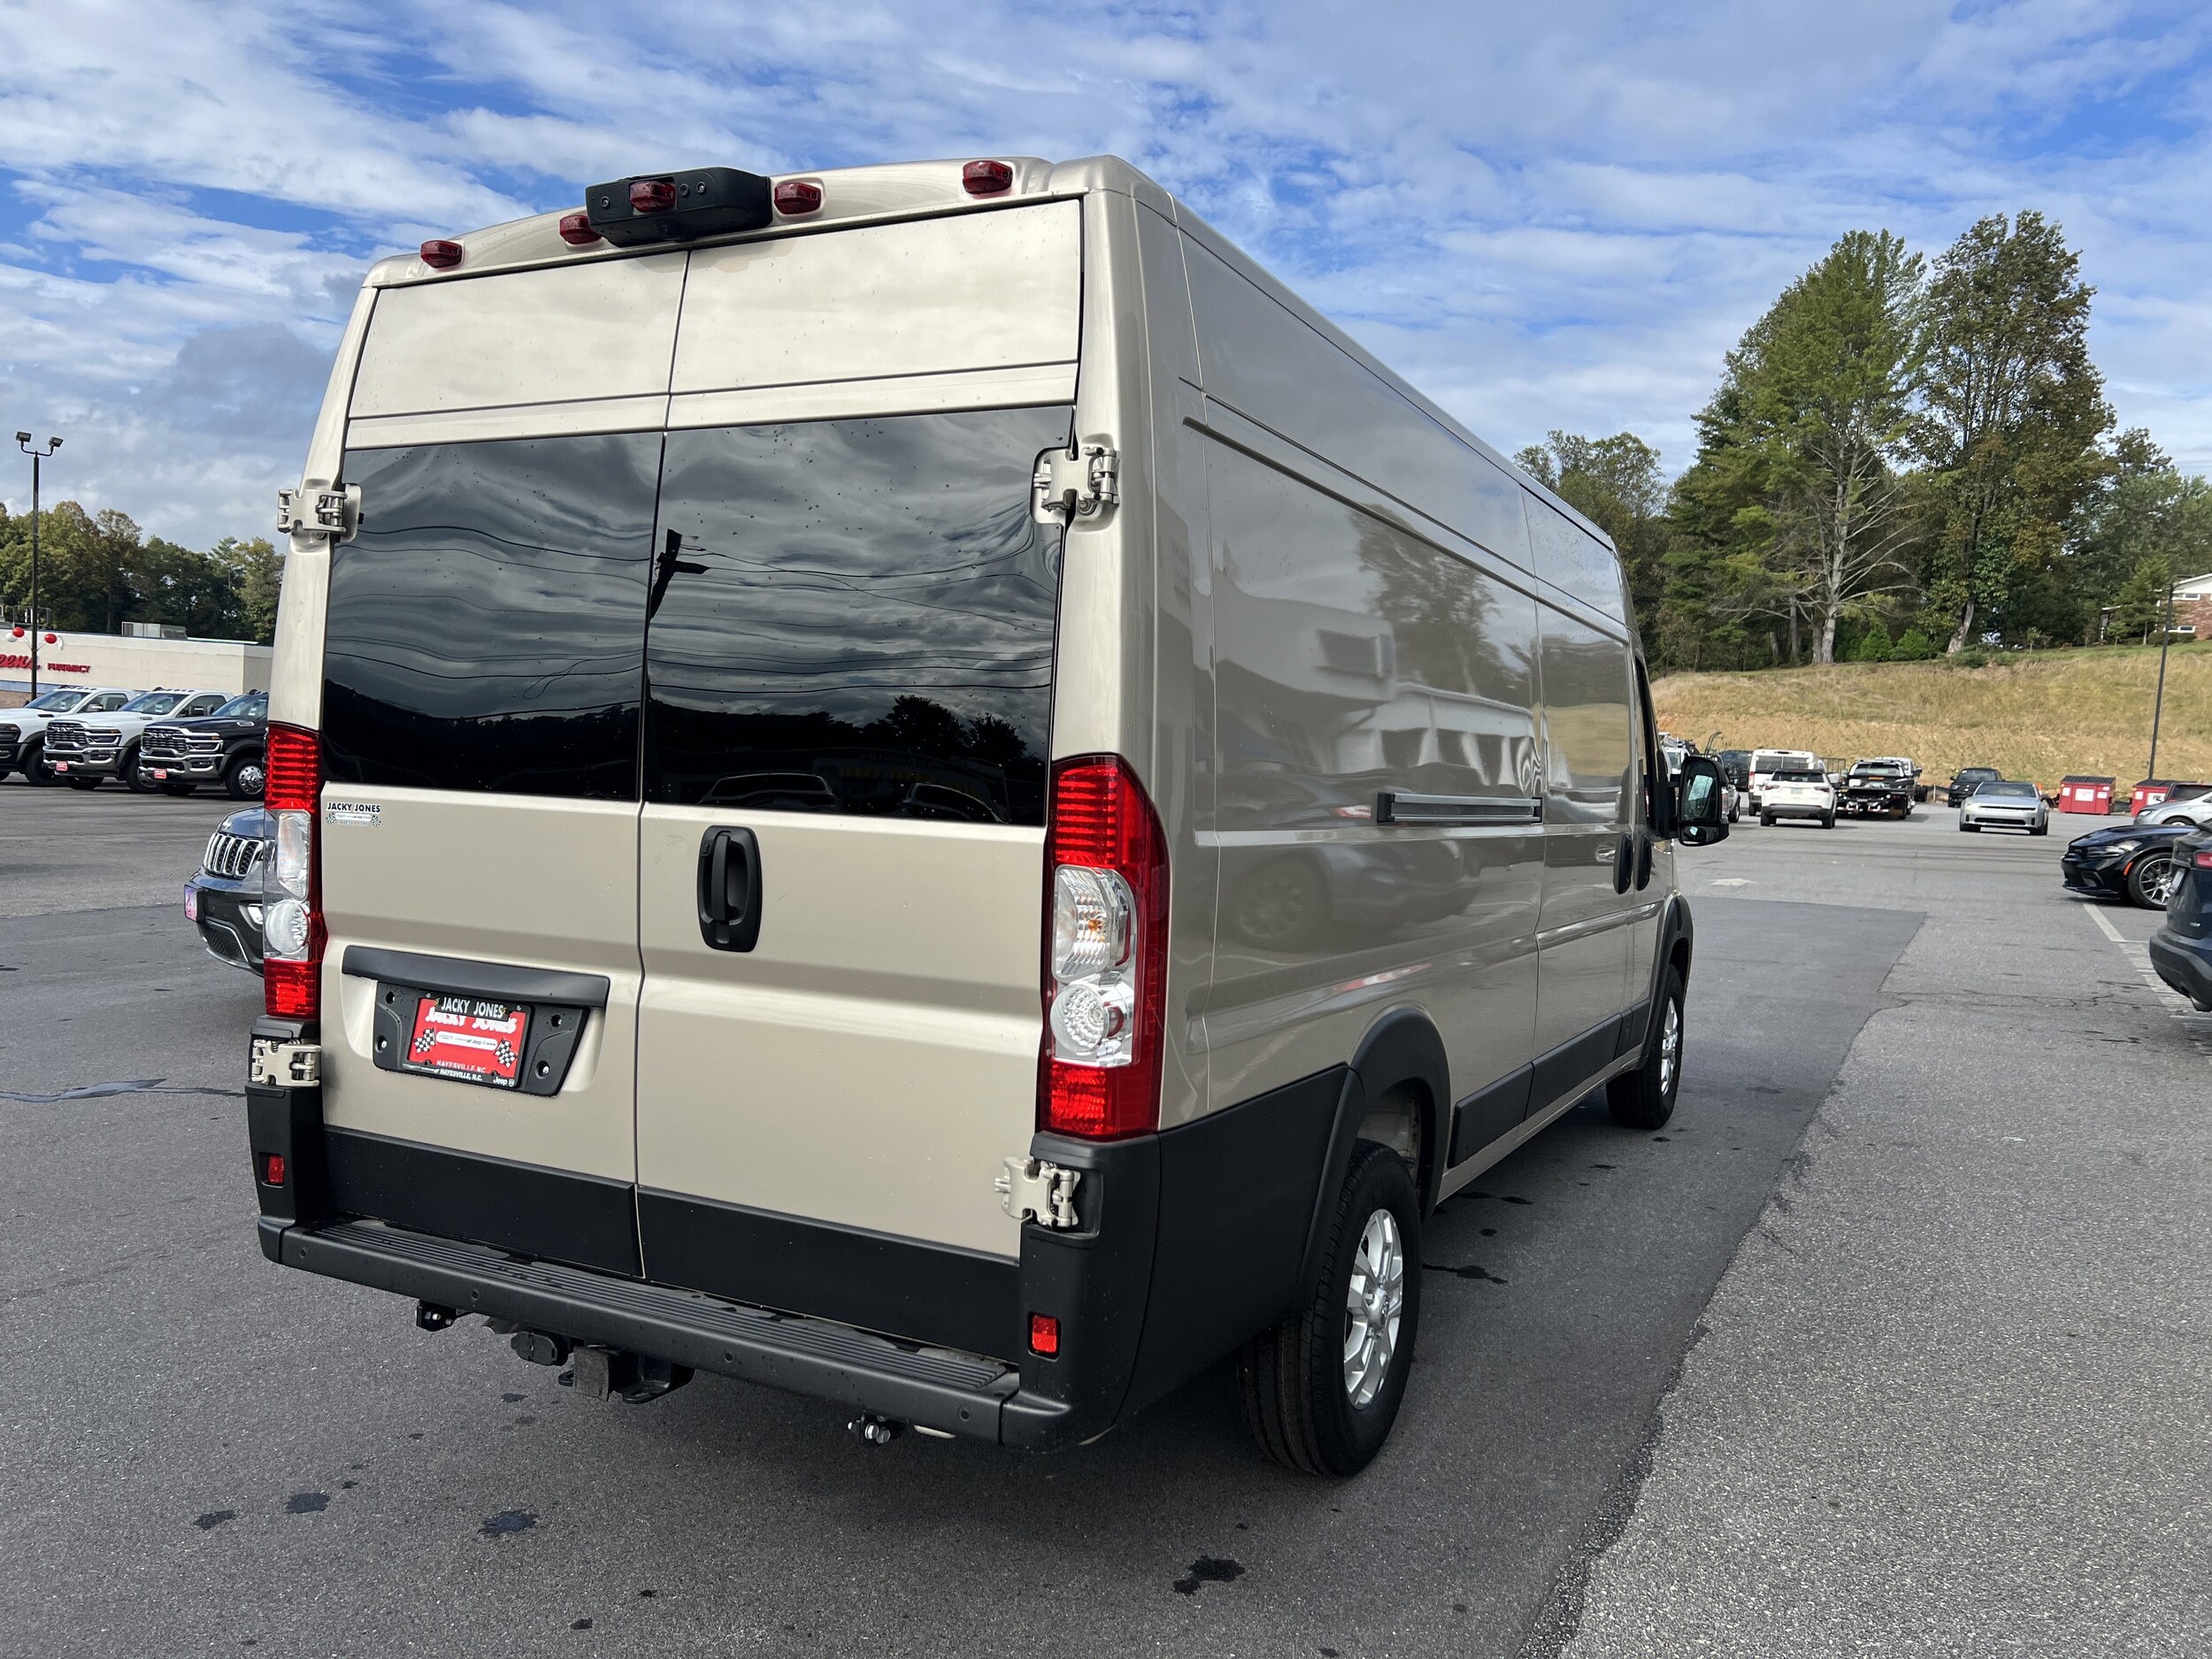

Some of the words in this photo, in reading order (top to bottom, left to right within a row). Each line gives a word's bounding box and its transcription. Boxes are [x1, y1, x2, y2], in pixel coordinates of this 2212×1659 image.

[47, 663, 91, 673] PHARMACY
[326, 802, 352, 811] JACKY
[354, 803, 380, 813] JONES
[441, 996, 471, 1014] JACKY
[473, 1002, 503, 1018] JONES
[440, 1068, 472, 1080] HAYESVILLE,
[493, 1076, 508, 1087] Jeep
